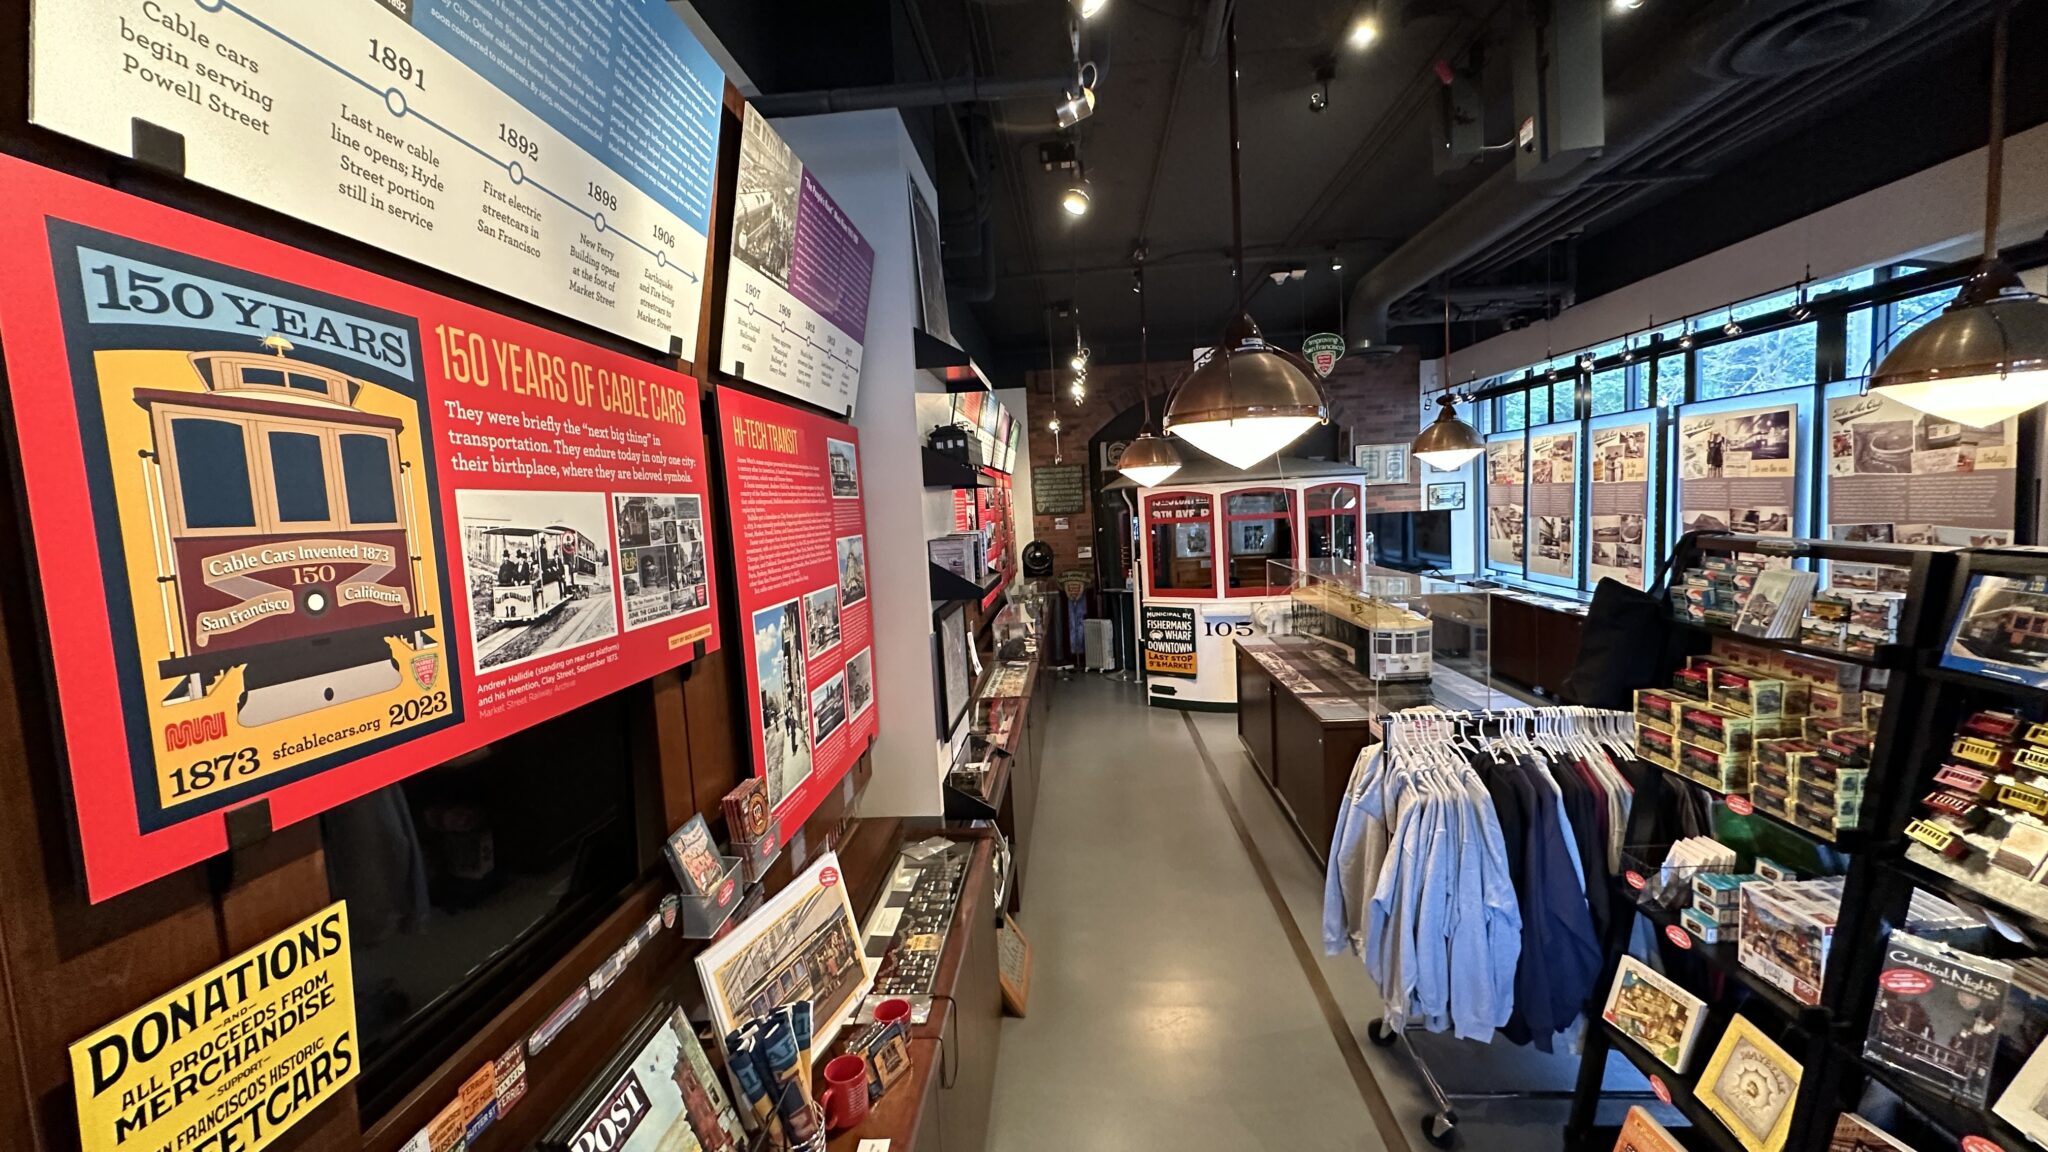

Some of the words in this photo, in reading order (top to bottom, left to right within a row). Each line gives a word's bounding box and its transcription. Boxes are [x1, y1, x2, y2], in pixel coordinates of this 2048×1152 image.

[143, 1, 209, 48] Cable
[216, 43, 260, 73] cars
[431, 8, 450, 27] soon
[451, 22, 488, 56] converted
[488, 51, 497, 62] to
[120, 18, 189, 69] begin
[196, 61, 273, 112] serving
[368, 39, 426, 91] 1891
[123, 53, 201, 104] Powell
[208, 95, 269, 135] Street
[340, 104, 373, 133] Last
[376, 125, 404, 149] new
[407, 142, 440, 168] cable
[498, 122, 539, 162] 1892
[331, 122, 361, 151] line
[364, 145, 409, 177] opens;
[411, 165, 445, 192] Hyde
[340, 155, 384, 187] Street
[387, 179, 435, 210] portion
[483, 180, 507, 205] First
[508, 195, 542, 222] electric
[587, 181, 618, 212] 1898
[338, 181, 367, 203] still
[371, 194, 385, 210] in
[387, 202, 434, 231] service
[482, 203, 529, 233] streetcars
[530, 226, 539, 239] in
[477, 219, 497, 239] San
[497, 227, 541, 258] Francisco
[579, 233, 596, 250] New
[597, 242, 615, 261] Ferry
[652, 224, 675, 249] 1906
[569, 245, 600, 271] Building
[601, 263, 620, 280] opens
[572, 266, 581, 277] at
[581, 269, 593, 282] the
[594, 274, 607, 288] foot
[608, 280, 616, 292] of
[644, 268, 674, 292] Earthquake
[569, 279, 595, 302] Market
[595, 291, 616, 309] Street
[639, 282, 651, 294] and
[651, 287, 662, 298] Fire
[661, 293, 675, 308] bring
[640, 298, 666, 317] streetcars
[666, 309, 672, 318] to
[745, 283, 761, 299] 1907
[779, 303, 791, 318] 1909
[91, 265, 215, 320] 150
[222, 292, 407, 368] YEARS
[637, 310, 656, 327] Market
[656, 317, 672, 332] Street
[435, 323, 489, 388] 150
[491, 338, 568, 403] YEARS
[570, 360, 595, 408] OF
[598, 368, 649, 419] CABLE
[649, 383, 687, 427] CARS
[444, 400, 483, 425] They
[487, 411, 520, 427] were
[522, 410, 561, 436] briefly
[563, 418, 581, 435] the
[609, 427, 625, 445] big
[652, 434, 661, 446] in
[733, 415, 768, 451] HI-TECH
[768, 424, 798, 455] TRANSIT
[447, 429, 552, 454] transportation.
[553, 439, 581, 460] They
[583, 445, 616, 460] endure
[618, 445, 641, 464] today
[642, 449, 650, 461] in
[651, 451, 668, 467] only
[668, 455, 681, 466] one
[681, 454, 696, 469] city:
[451, 453, 489, 472] their
[492, 454, 560, 479] birthplace,
[562, 463, 594, 479] where
[595, 464, 616, 483] they
[617, 468, 632, 480] are
[633, 467, 662, 482] beloved
[663, 469, 693, 486] symbols.
[209, 552, 258, 577] Cable
[260, 548, 296, 564] Cars
[298, 545, 358, 560] Invented
[362, 546, 390, 562] 1873
[291, 564, 336, 586] 150
[344, 587, 401, 603] California
[201, 614, 228, 632] San
[231, 598, 290, 627] Francisco
[1147, 620, 1192, 631] FISHERMANS
[1204, 621, 1254, 637] 105
[1148, 641, 1193, 653] DOWNTOWN
[1165, 630, 1192, 641] WHARF
[477, 677, 506, 694] Andrew
[508, 669, 534, 684] Hallidie
[535, 660, 565, 677] (standing
[565, 658, 574, 667] on
[574, 654, 586, 664] rear
[586, 651, 595, 661] car
[1149, 652, 1169, 662] LAST
[1171, 654, 1193, 662] STOP
[1162, 661, 1193, 669] MARKET
[478, 694, 494, 707] and
[495, 690, 506, 702] his
[507, 681, 541, 699] invention,
[541, 674, 556, 687] Clay
[556, 668, 576, 682] Street,
[576, 659, 606, 675] September
[388, 691, 448, 728] 2023
[480, 705, 505, 719] Market
[506, 696, 528, 709] Street
[529, 688, 553, 703] Railway
[272, 718, 381, 761] sfcablecars.org
[170, 746, 261, 798] 1873
[1889, 950, 1950, 979] Celestial
[1951, 969, 2000, 997] Nights
[88, 912, 342, 1098] DONATIONS
[121, 1076, 163, 1112] ALL
[170, 1003, 276, 1081] PROCEEDS
[281, 970, 329, 1011] FROM
[115, 984, 336, 1146] MERCHANDISE
[177, 1075, 266, 1151] FRANCISCO'S
[269, 1037, 325, 1086] HISTORIC
[571, 1080, 644, 1152] POST
